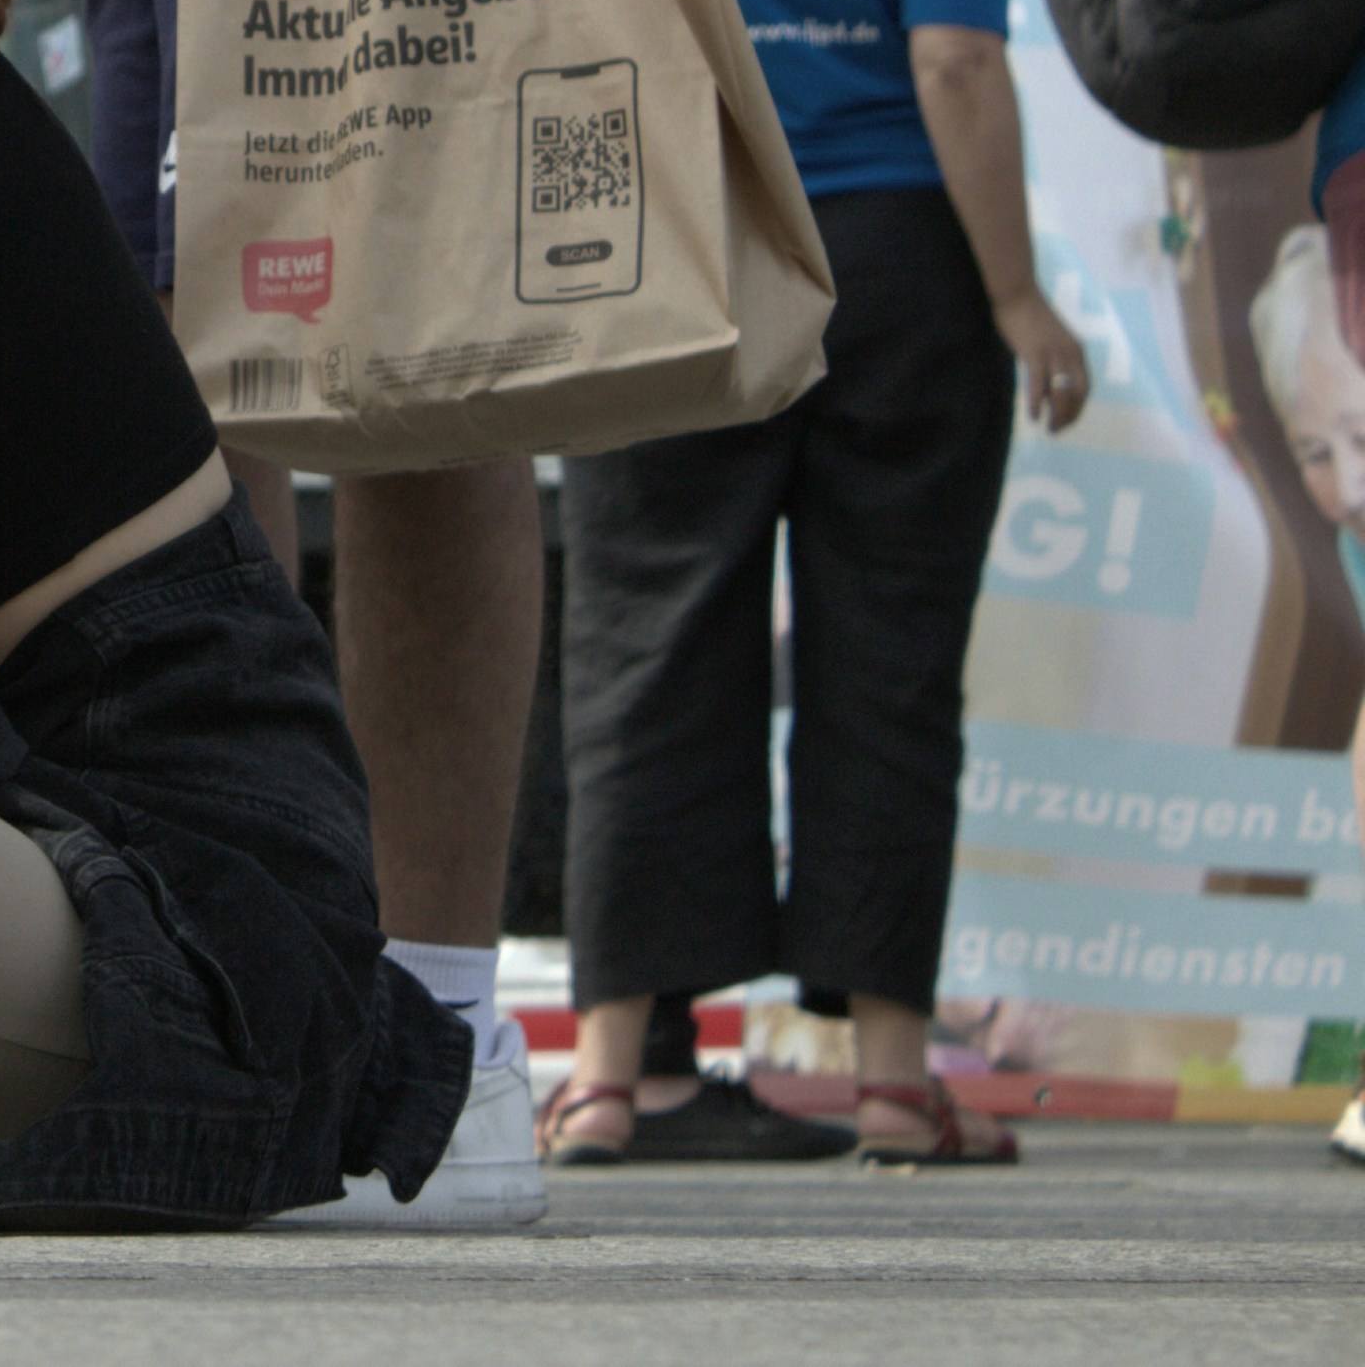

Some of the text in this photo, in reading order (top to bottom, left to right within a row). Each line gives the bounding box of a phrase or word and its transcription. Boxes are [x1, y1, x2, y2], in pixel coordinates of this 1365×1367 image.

[353, 21, 476, 74] dabei!
[385, 104, 432, 131] App
[257, 252, 326, 279] REWE
[992, 473, 1143, 595] G!
[963, 758, 1279, 850] ürzungen
[954, 922, 1346, 989] gendiensten
